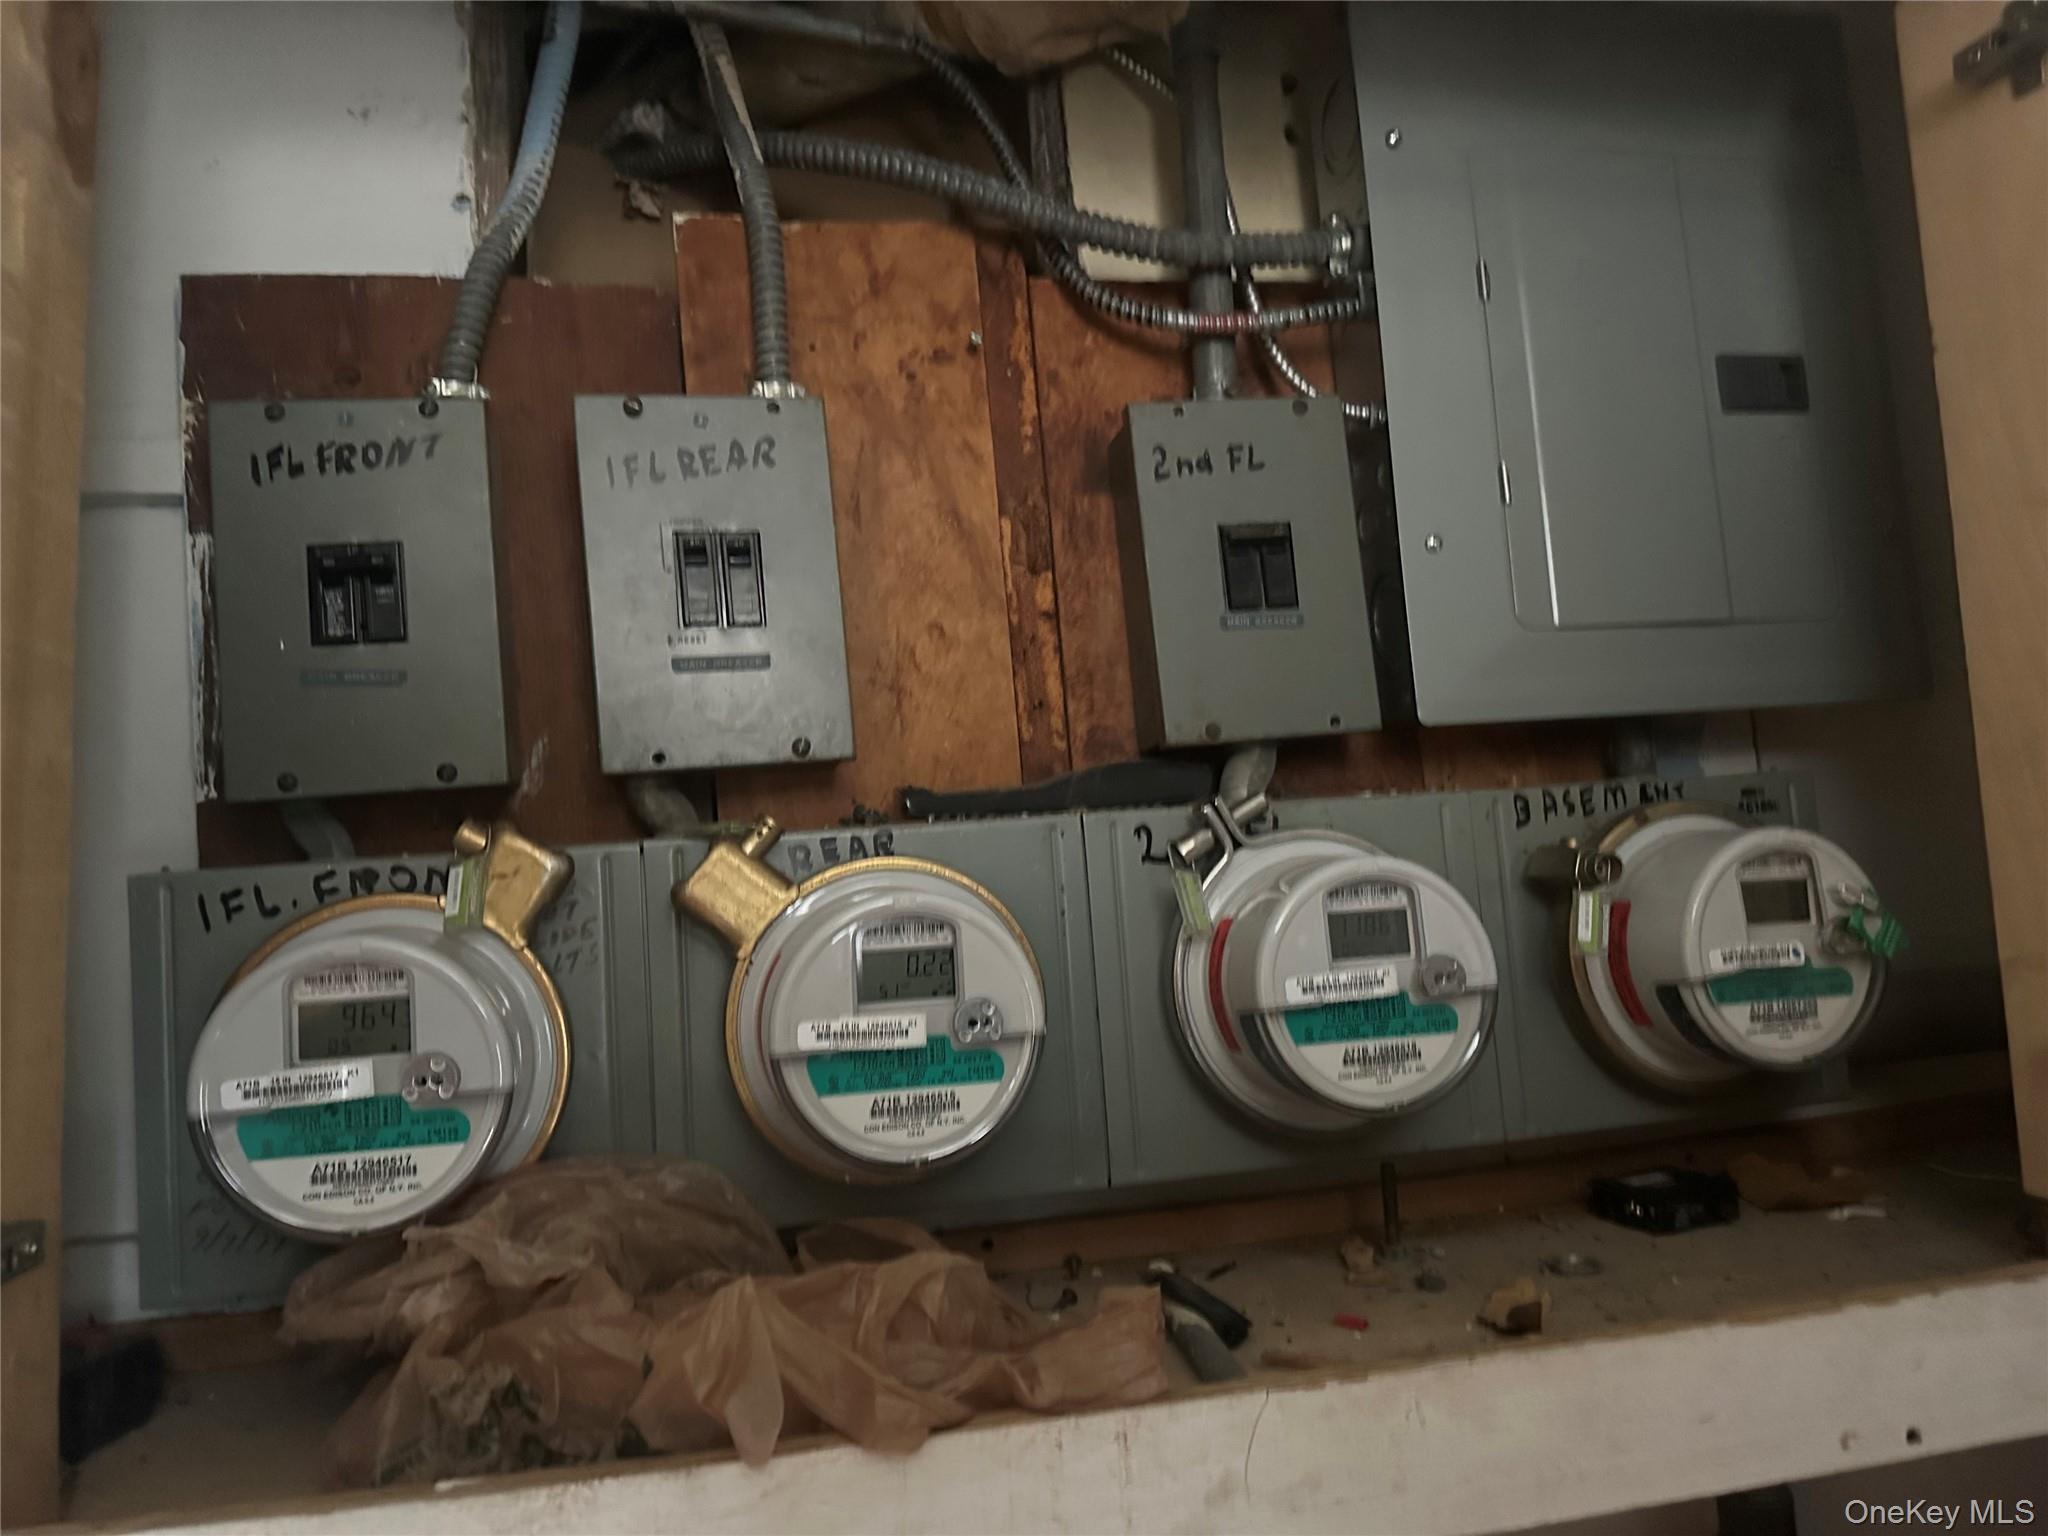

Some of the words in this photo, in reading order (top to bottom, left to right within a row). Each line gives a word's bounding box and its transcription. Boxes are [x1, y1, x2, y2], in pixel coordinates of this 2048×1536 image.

[316, 432, 443, 476] FRONT
[677, 435, 776, 482] REAR
[1152, 443, 1214, 482] 2nd
[1227, 442, 1266, 473] FL
[787, 829, 895, 877] REAR
